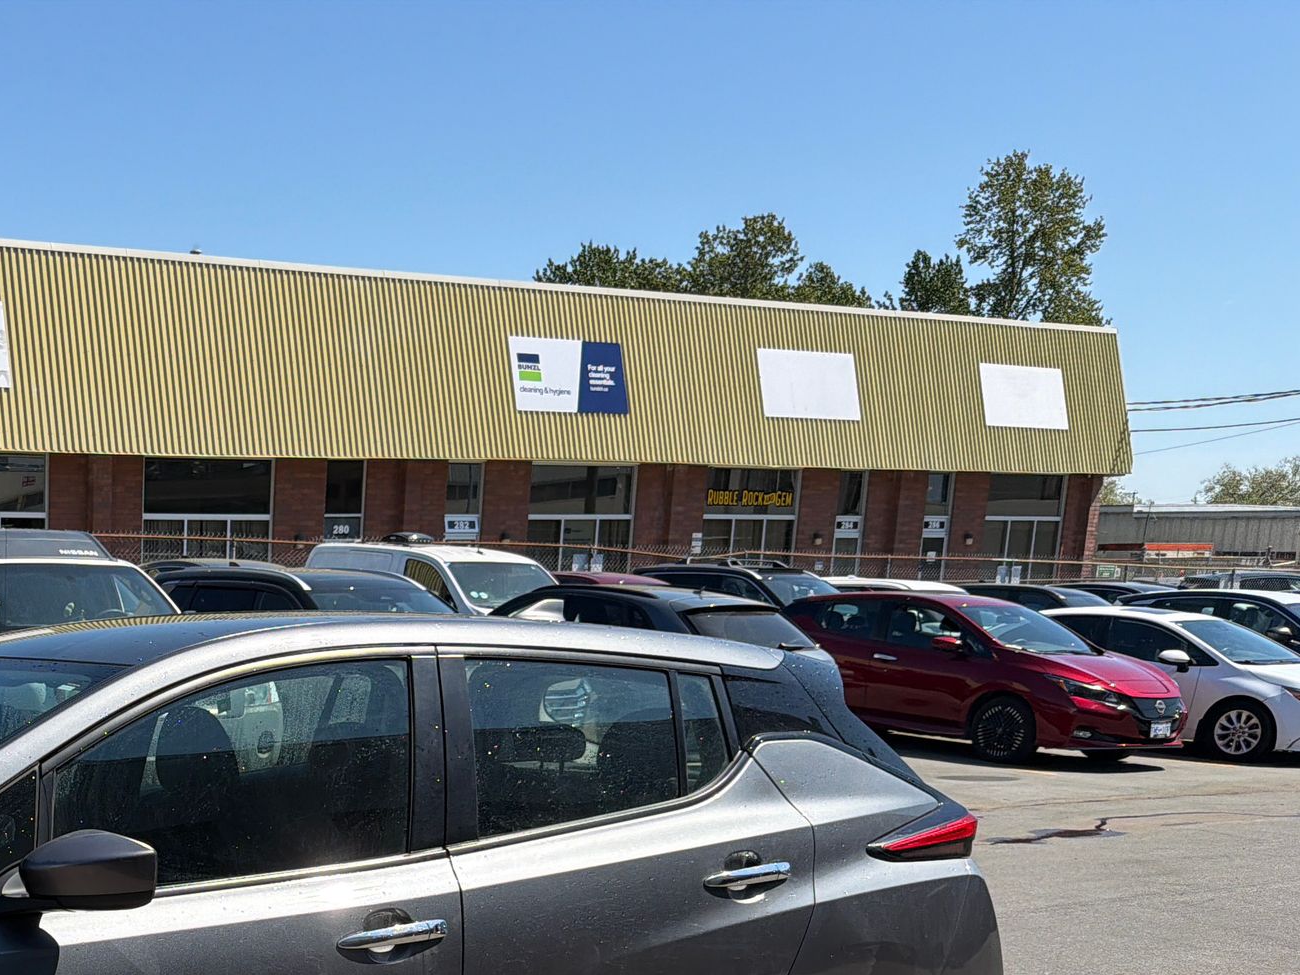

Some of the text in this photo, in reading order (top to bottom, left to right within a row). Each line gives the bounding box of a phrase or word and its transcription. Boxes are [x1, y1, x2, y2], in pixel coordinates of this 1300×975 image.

[520, 385, 543, 395] cleaning
[549, 387, 571, 397] hygiene
[707, 489, 739, 506] RUBBLE
[741, 490, 764, 506] ROCK
[775, 491, 793, 507] GEM
[333, 525, 350, 535] 280
